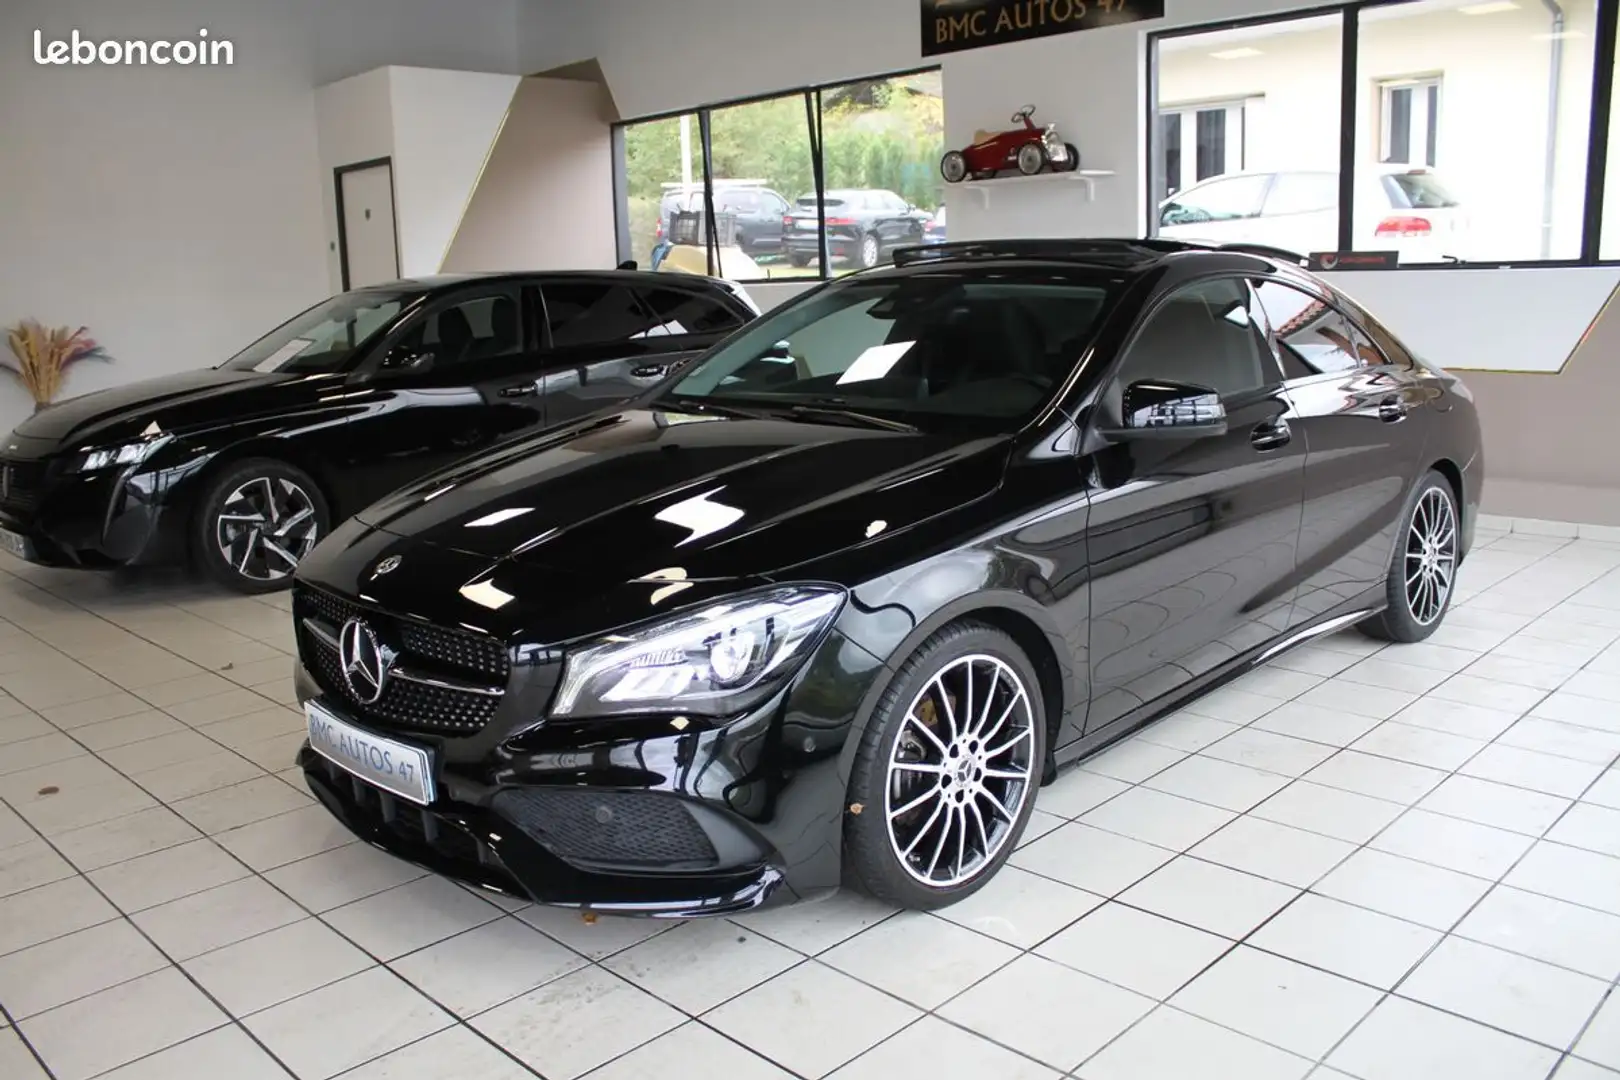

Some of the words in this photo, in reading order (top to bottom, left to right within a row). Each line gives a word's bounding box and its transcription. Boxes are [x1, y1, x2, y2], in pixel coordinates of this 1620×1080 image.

[935, 10, 986, 44] BMC
[994, 0, 1086, 32] AUTOS
[309, 713, 333, 744] BMC
[340, 733, 393, 775] AUTOS
[398, 761, 414, 783] 47
